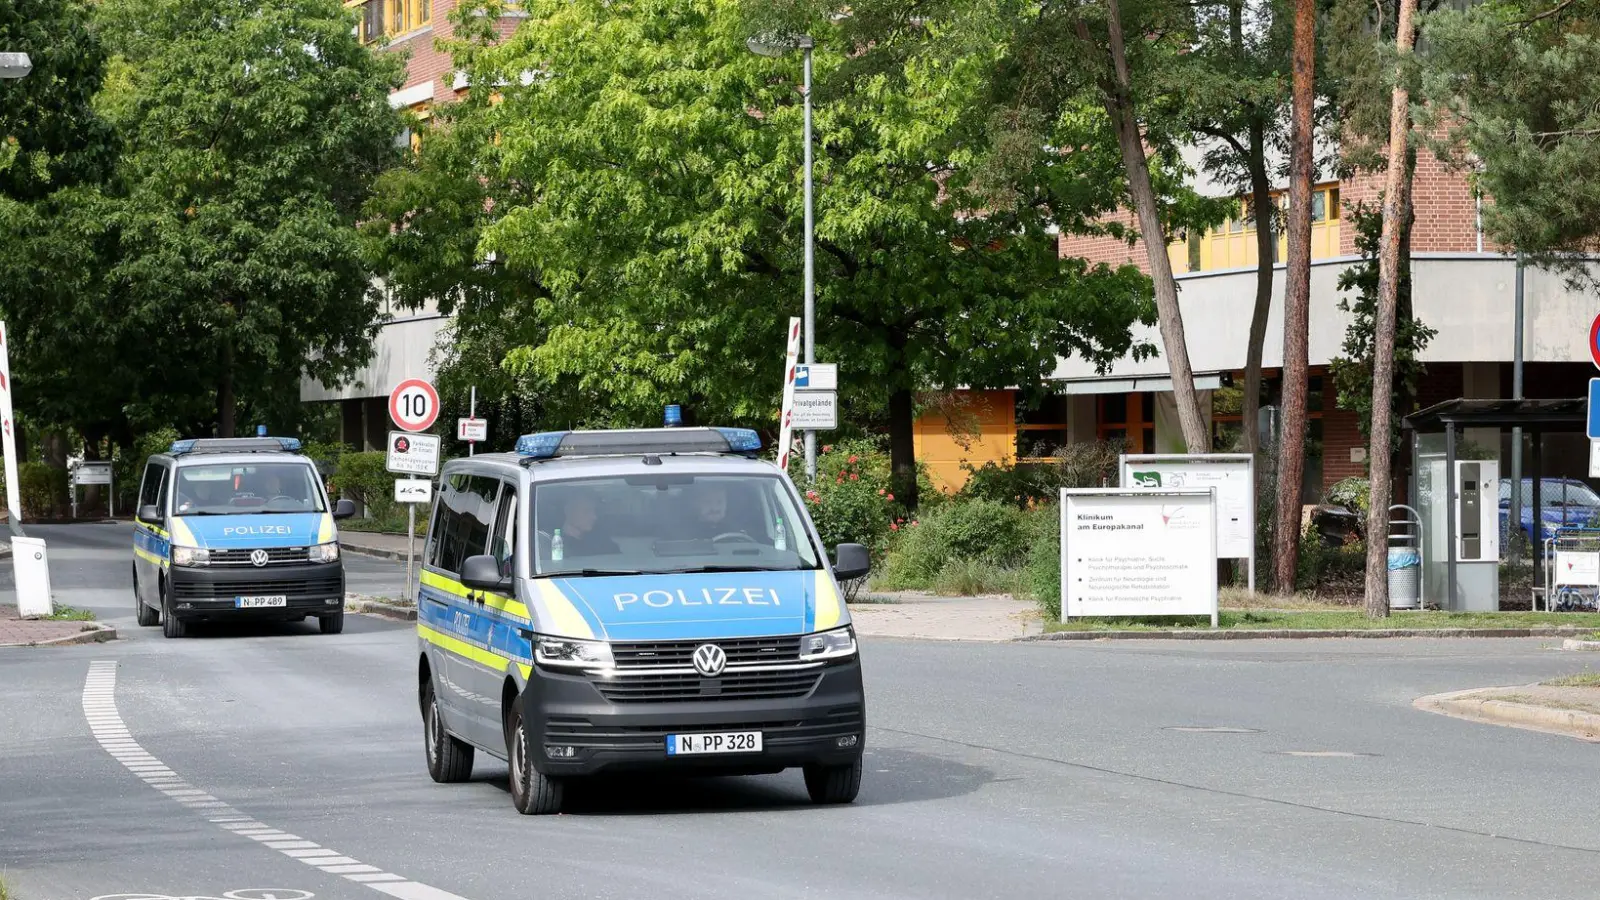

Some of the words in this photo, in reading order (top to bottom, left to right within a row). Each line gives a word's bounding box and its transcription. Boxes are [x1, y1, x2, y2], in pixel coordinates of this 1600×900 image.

[403, 394, 425, 417] 10
[223, 526, 291, 535] POLIZEI
[1092, 523, 1144, 531] Europakanal
[243, 598, 250, 606] N
[254, 598, 266, 606] PP
[267, 597, 283, 605] 489
[613, 588, 780, 612] POLIZEI
[682, 736, 692, 751] N
[703, 735, 723, 751] PP
[727, 734, 755, 750] 328
